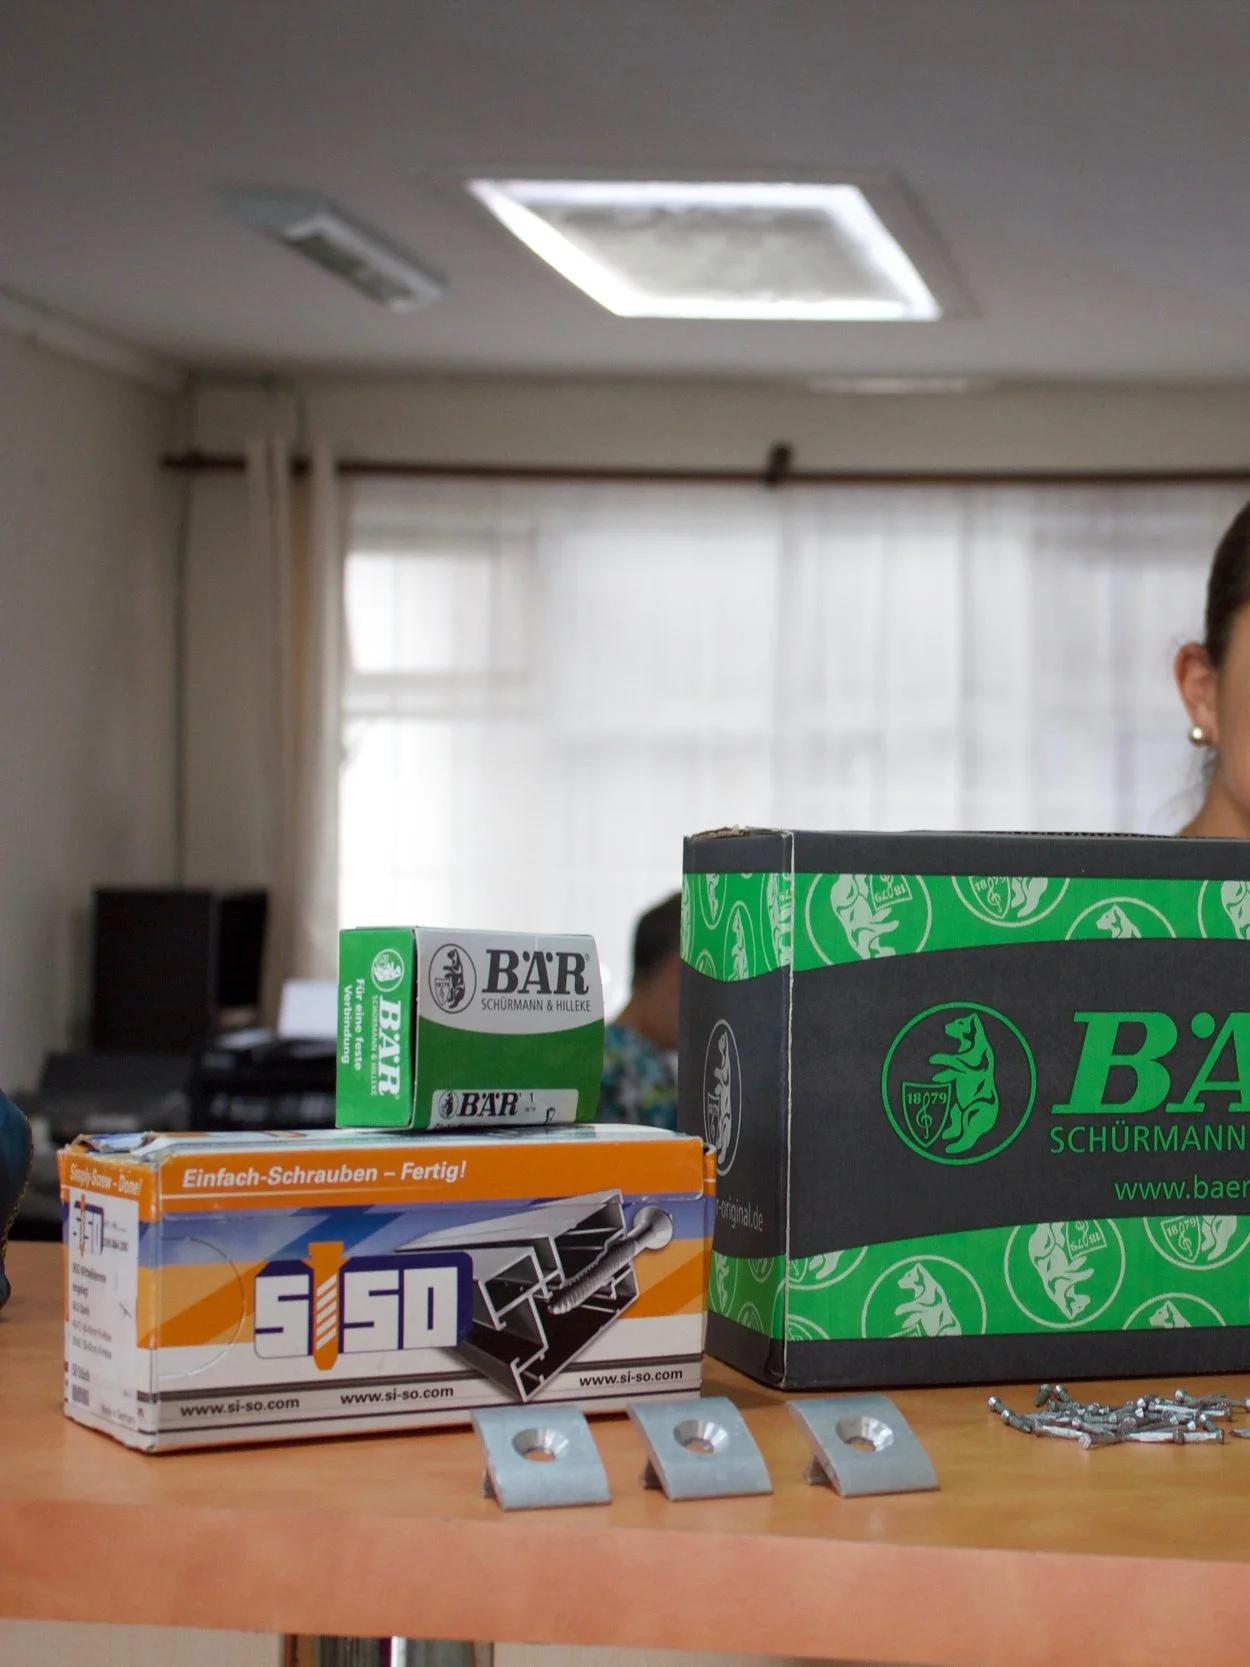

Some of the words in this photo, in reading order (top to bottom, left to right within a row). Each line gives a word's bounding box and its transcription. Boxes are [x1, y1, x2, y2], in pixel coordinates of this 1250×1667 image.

[355, 978, 365, 1000] Für
[481, 996, 544, 1012] SCHÜRMANN
[546, 999, 553, 1012] &
[556, 1000, 592, 1013] HILLEKE
[341, 984, 352, 1065] Verbindung
[354, 1003, 364, 1033] eine
[354, 1037, 365, 1071] feste
[906, 1091, 948, 1105] 1879
[1050, 1120, 1247, 1153] SCHÜRMANN
[182, 1164, 378, 1189] Einfach-Schrauben
[401, 1160, 468, 1183] Fertig!
[580, 1368, 683, 1387] www.si-so.com
[340, 1385, 454, 1405] www.si-so.com
[180, 1397, 300, 1418] www.si-so.com
